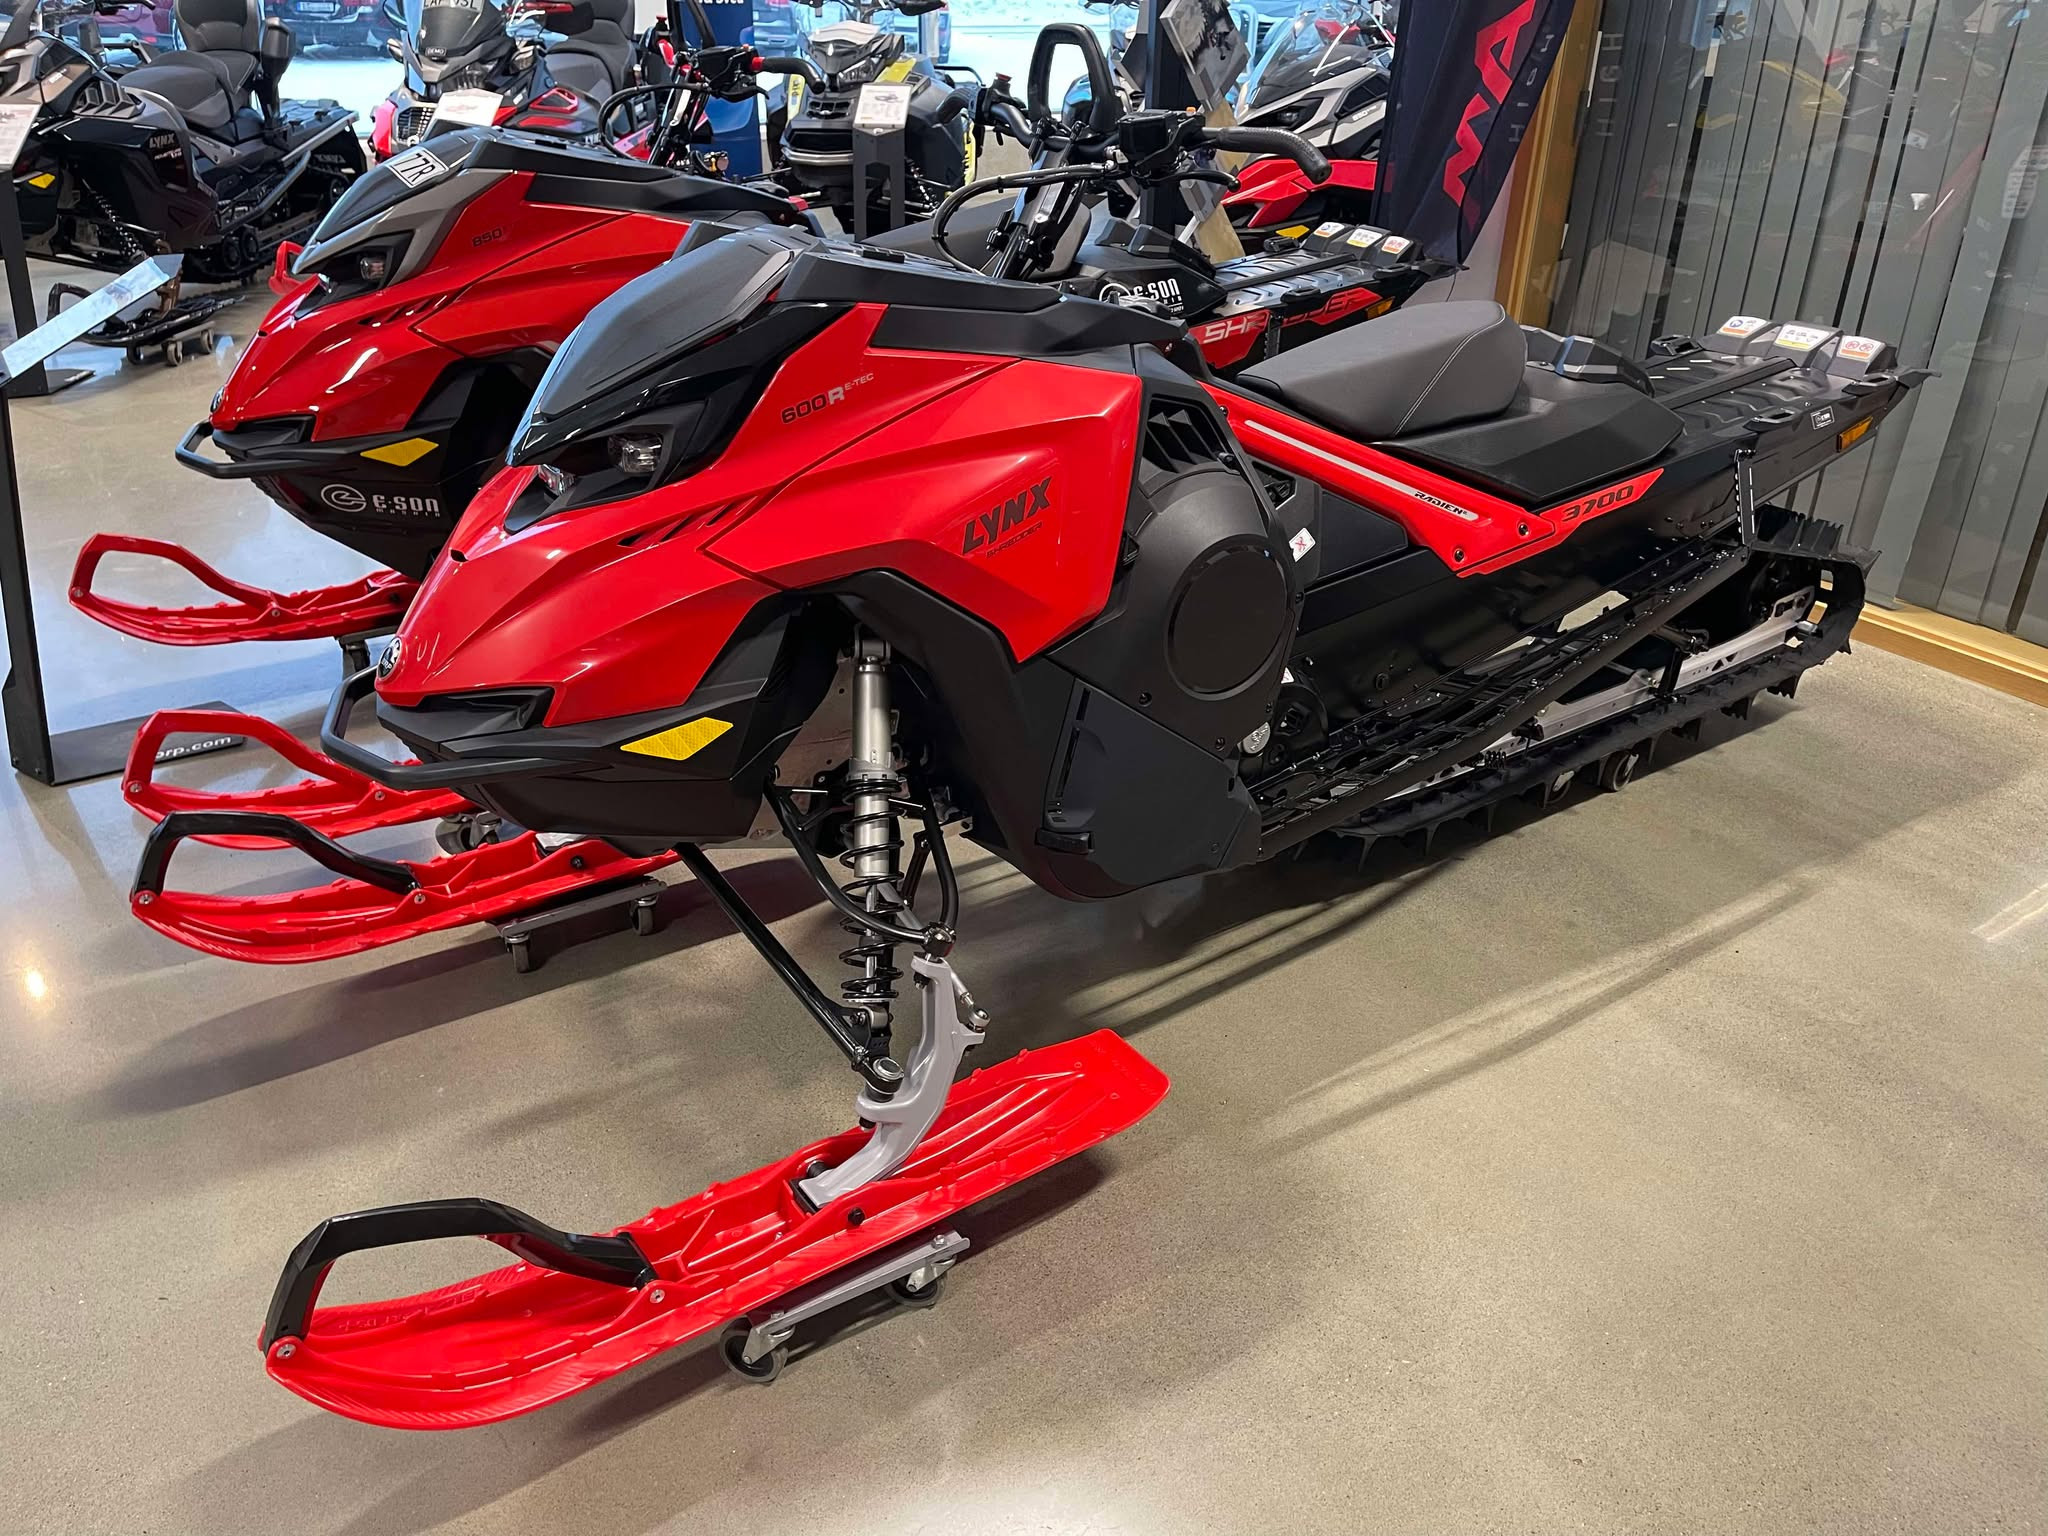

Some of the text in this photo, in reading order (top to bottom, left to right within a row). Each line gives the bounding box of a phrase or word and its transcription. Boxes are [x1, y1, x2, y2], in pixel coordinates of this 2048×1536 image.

[149, 133, 175, 149] LYNX
[472, 228, 503, 247] 850
[844, 373, 875, 391] E-TEC
[1562, 484, 1634, 522] 3700
[962, 475, 1053, 556] LYNX
